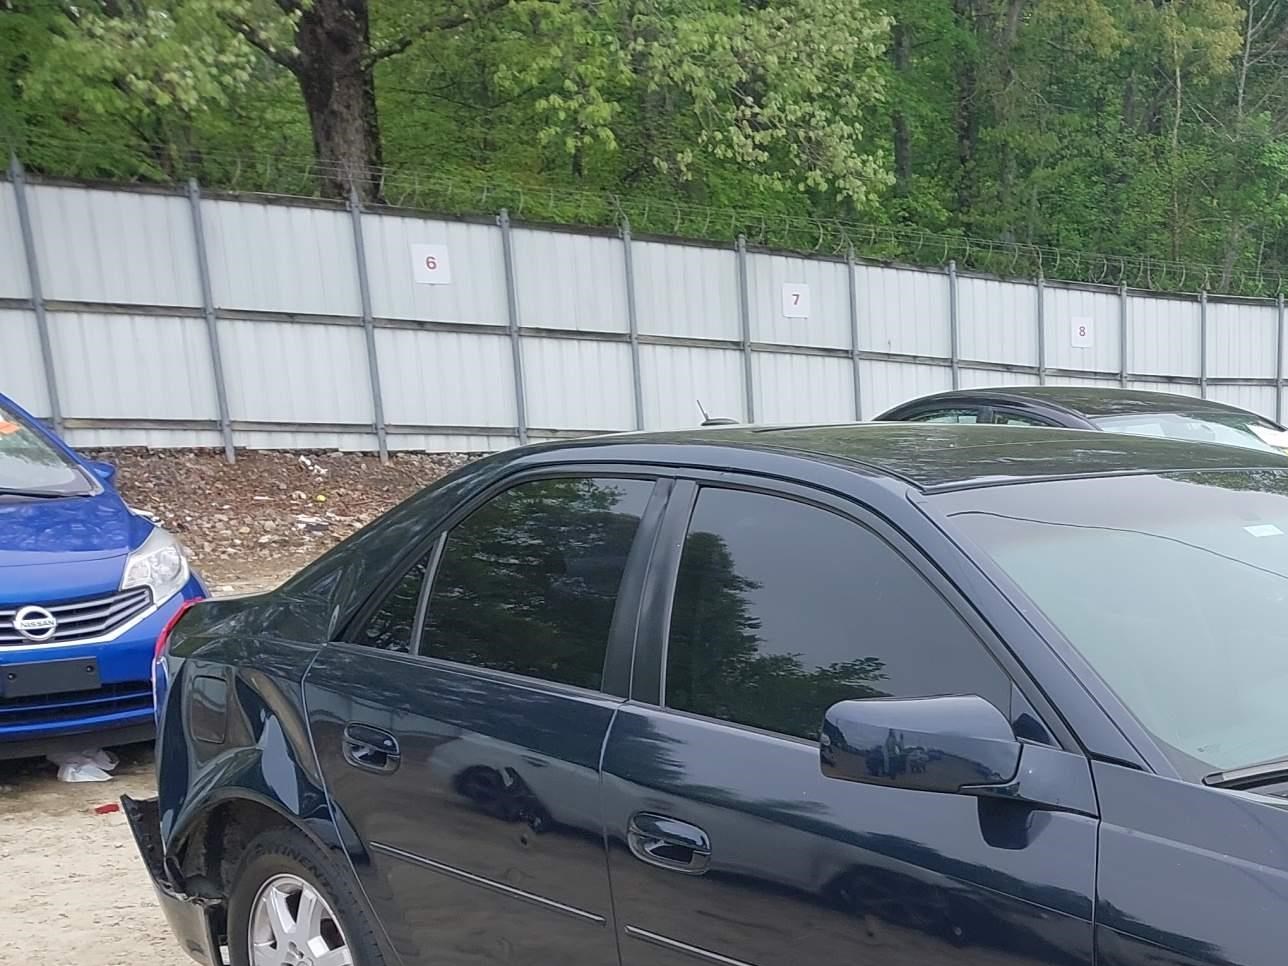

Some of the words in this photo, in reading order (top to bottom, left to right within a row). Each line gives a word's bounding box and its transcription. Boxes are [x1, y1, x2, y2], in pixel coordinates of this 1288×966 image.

[425, 255, 437, 271] 6
[791, 293, 801, 306] 7
[1079, 325, 1086, 337] 8
[20, 619, 55, 628] NISSAN
